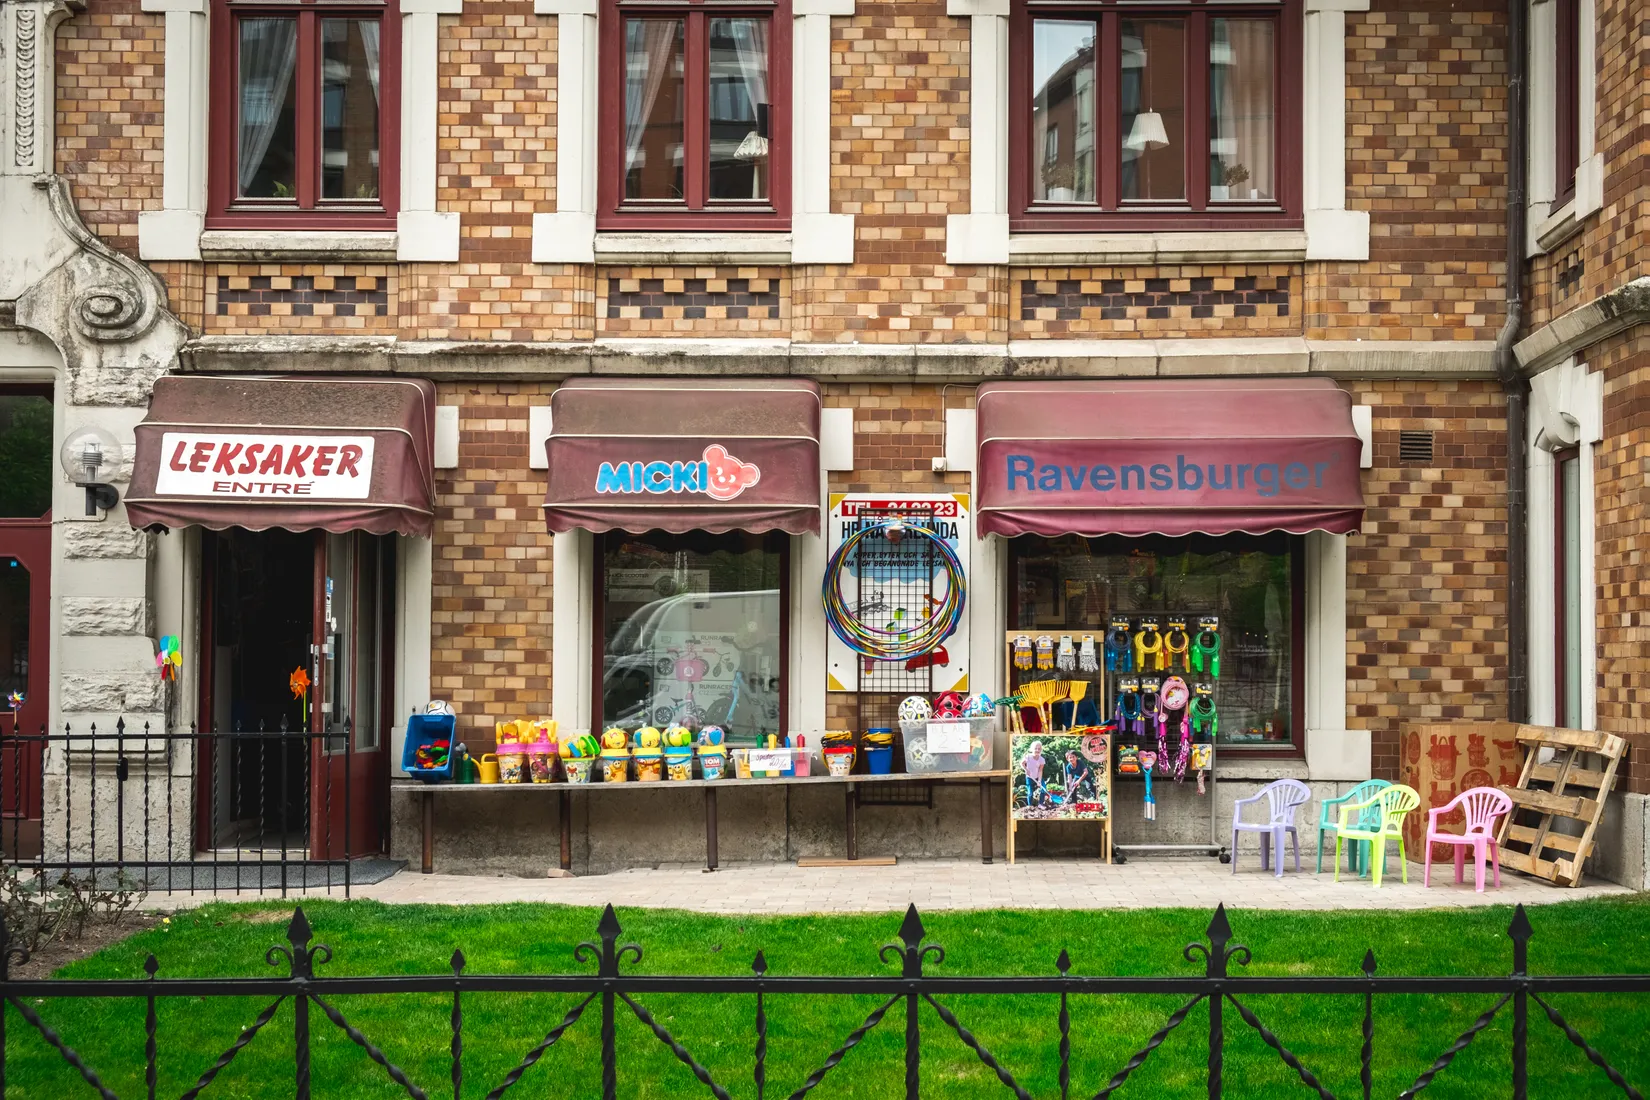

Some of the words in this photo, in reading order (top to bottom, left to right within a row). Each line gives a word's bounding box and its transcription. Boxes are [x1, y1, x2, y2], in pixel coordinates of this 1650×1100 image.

[169, 441, 363, 478] LEKSAKER
[1006, 455, 1329, 497] Ravensburger
[212, 481, 315, 494] ENTRÉ
[596, 461, 709, 494] MICKI
[934, 502, 954, 515] 23
